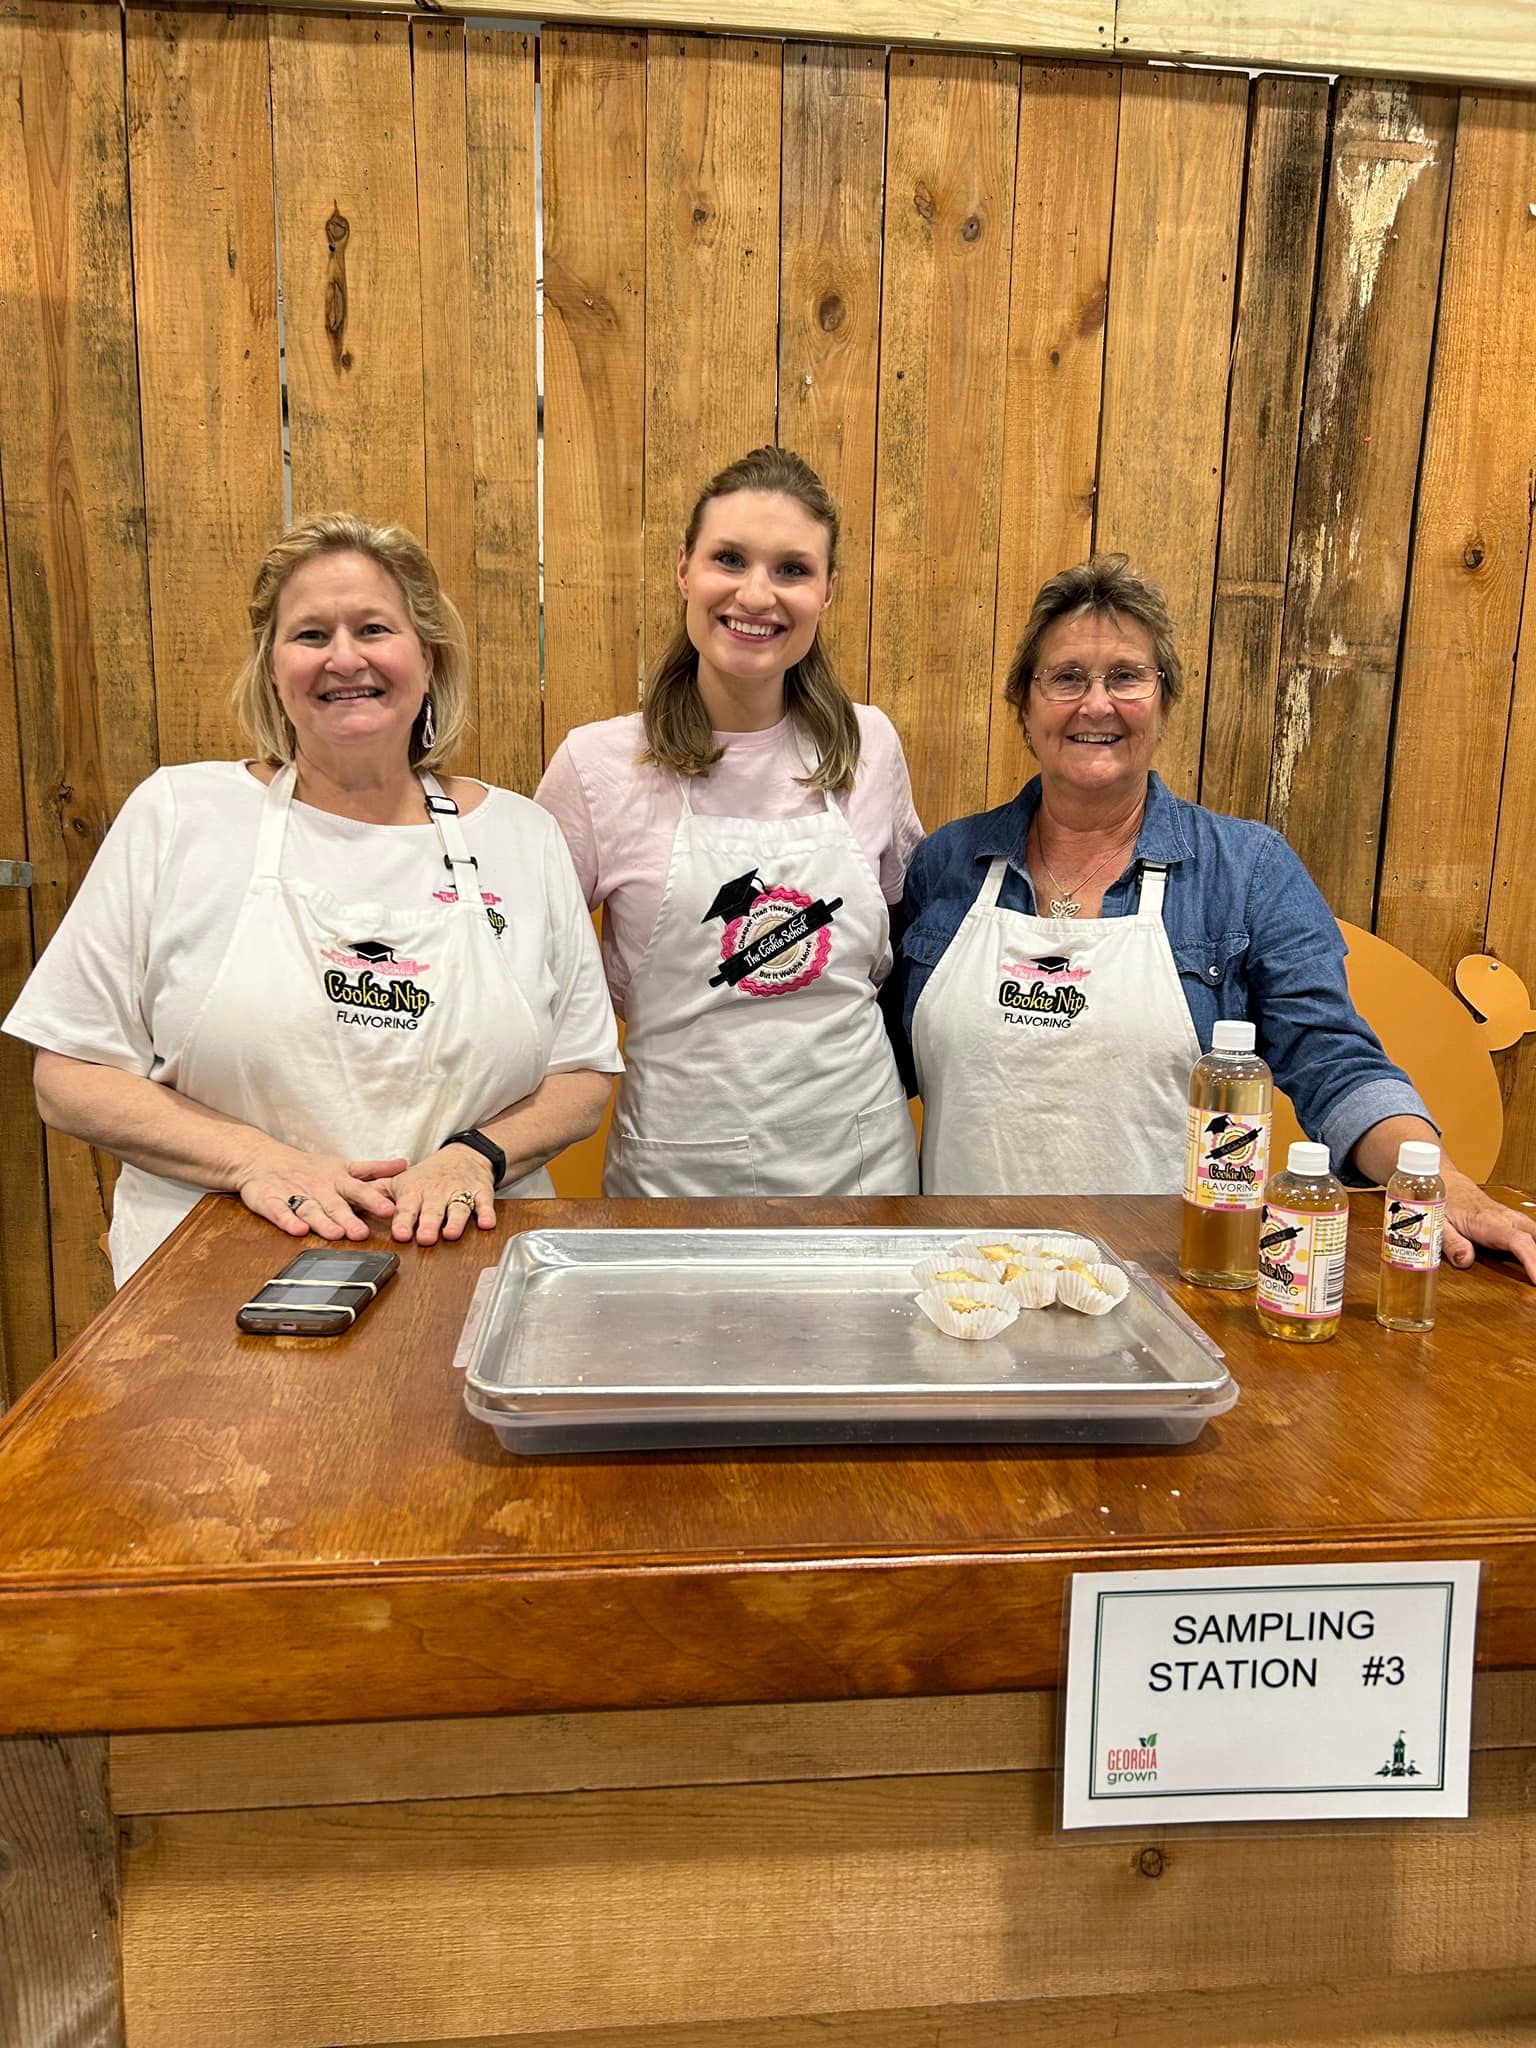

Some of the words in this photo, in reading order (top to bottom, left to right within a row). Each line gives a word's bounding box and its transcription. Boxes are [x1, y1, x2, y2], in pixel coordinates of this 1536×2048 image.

[752, 909, 767, 920] Than
[768, 906, 798, 916] Therapy
[743, 951, 761, 967] The
[758, 935, 785, 958] Cookie
[780, 914, 809, 943] School
[759, 970, 771, 980] But
[779, 962, 803, 978] Weighs
[326, 971, 390, 1009] Cookie
[390, 981, 429, 1017] Nip
[1000, 981, 1054, 1011] Cookie
[1054, 986, 1085, 1018] Nip
[337, 1011, 418, 1030] FLAVORING
[1004, 1013, 1071, 1028] FLAVORING
[1209, 1163, 1241, 1181] Cookie
[1240, 1165, 1256, 1184] Nip
[1202, 1180, 1259, 1192] FLAVORING
[1275, 1264, 1294, 1285] Nip
[1173, 1611, 1375, 1645] SAMPLING
[1149, 1658, 1318, 1692] STATION
[1362, 1656, 1405, 1687] #3
[1108, 1748, 1158, 1771] GEORGIA
[1107, 1770, 1158, 1785] grown
